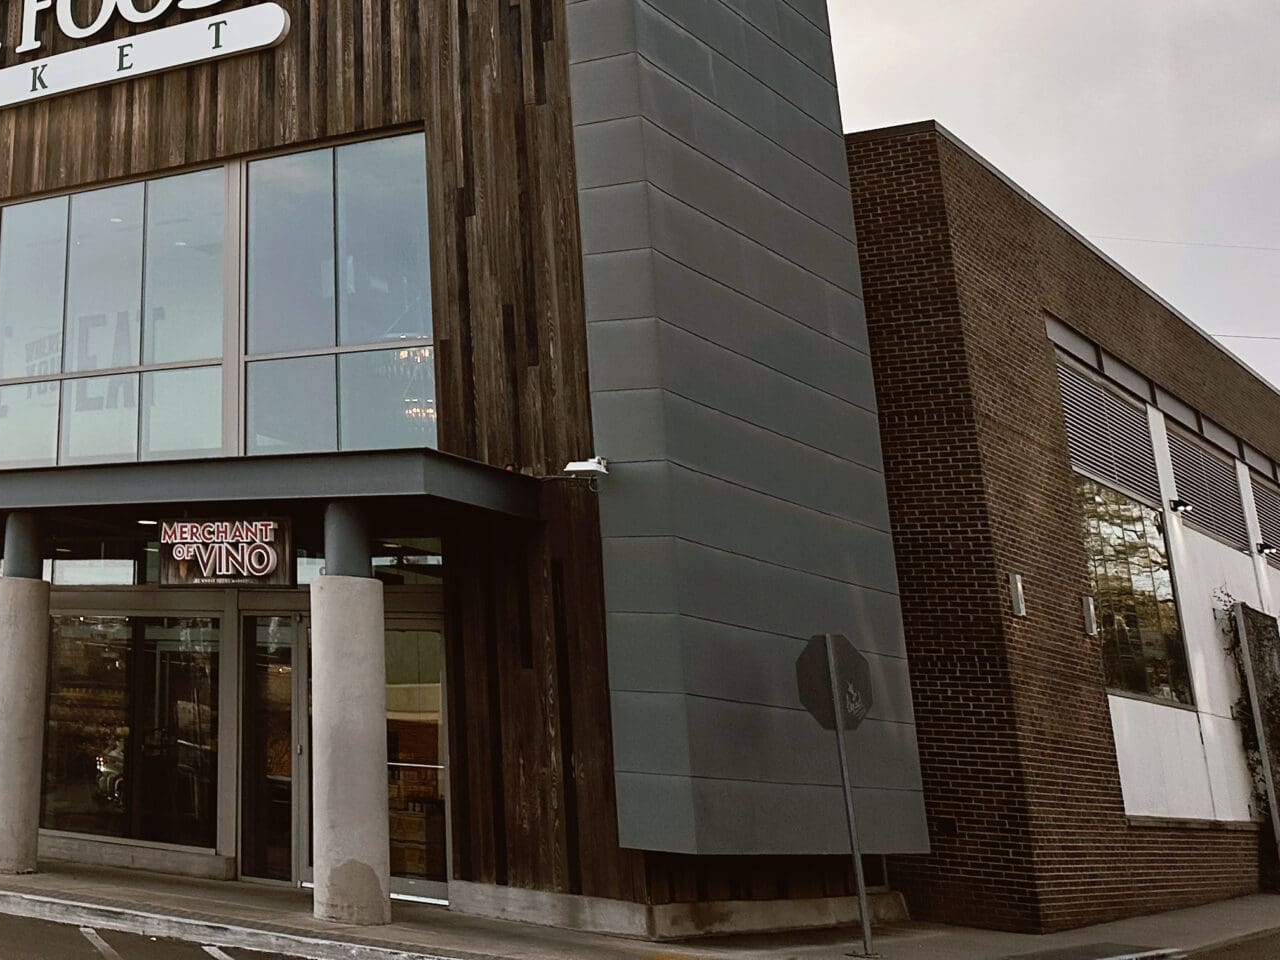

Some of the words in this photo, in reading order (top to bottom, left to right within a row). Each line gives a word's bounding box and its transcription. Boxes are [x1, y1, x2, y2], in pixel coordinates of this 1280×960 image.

[75, 306, 165, 412] EAT
[161, 520, 275, 544] MERCHANT
[172, 543, 194, 560] OF
[194, 542, 275, 577] VINO
